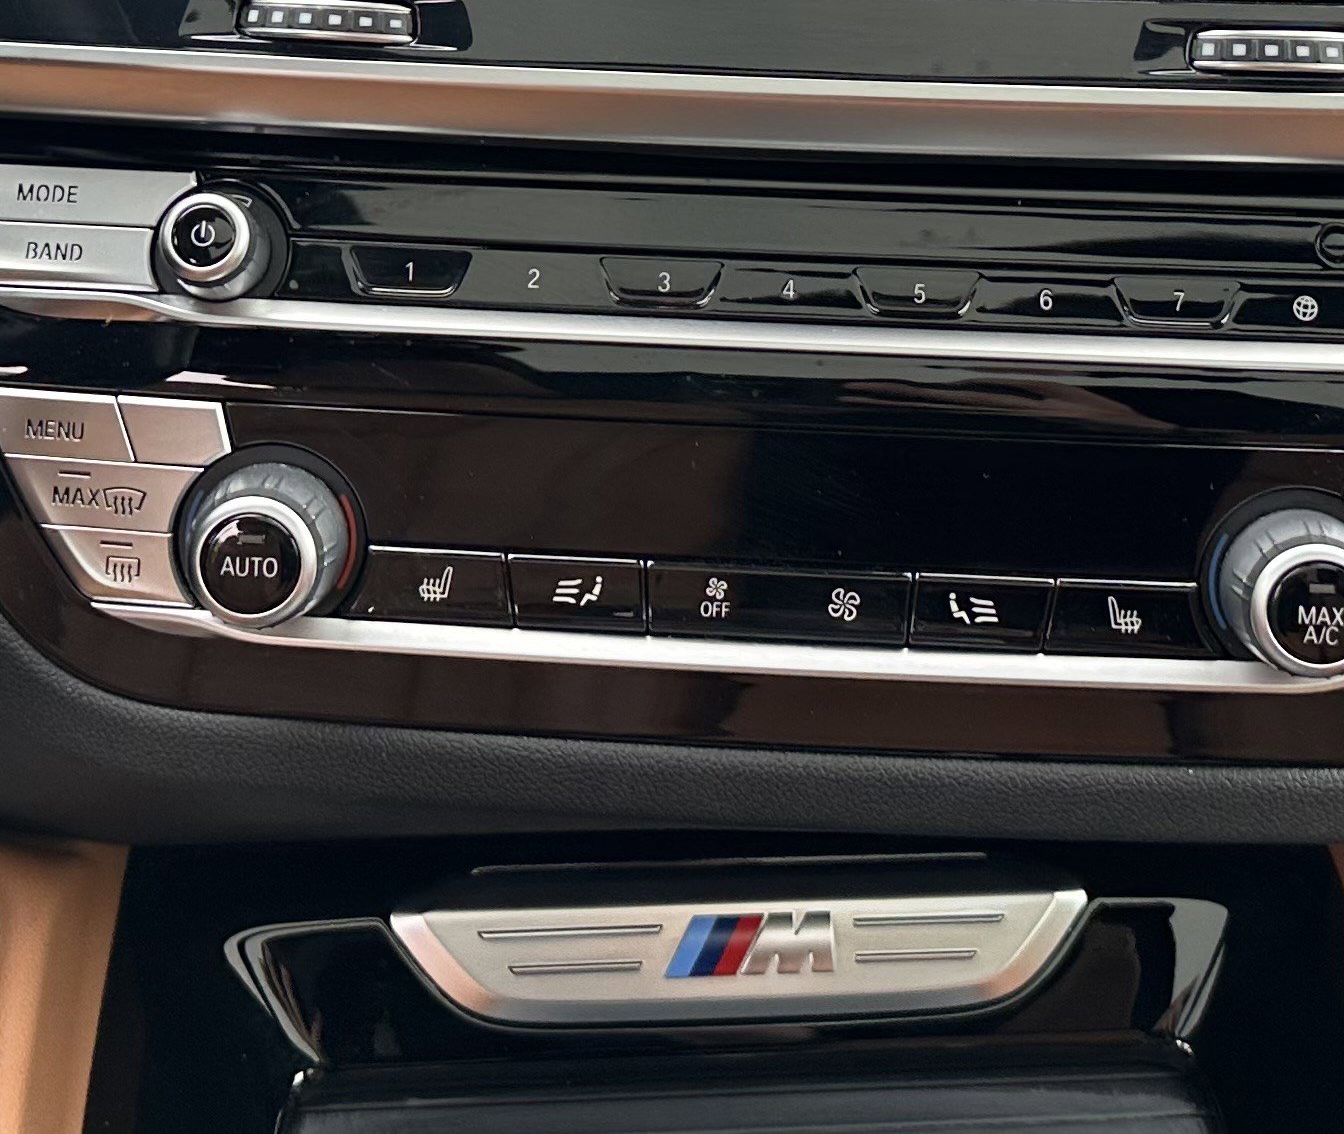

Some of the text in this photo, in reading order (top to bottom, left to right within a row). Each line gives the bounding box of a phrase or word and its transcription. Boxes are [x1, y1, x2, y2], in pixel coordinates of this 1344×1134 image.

[16, 183, 79, 206] MODE
[27, 241, 84, 262] BAND
[405, 261, 415, 282] 1
[527, 269, 540, 289] 2
[658, 272, 671, 292] 3
[781, 278, 795, 300] 4
[913, 284, 926, 303] 5
[1040, 289, 1053, 310] 6
[1173, 291, 1185, 312] 7
[25, 418, 85, 443] MENU
[52, 486, 100, 509] MAX
[220, 556, 279, 579] AUTO
[700, 600, 730, 620] OFF
[1298, 606, 1344, 627] MAX
[1304, 625, 1339, 647] A/C
